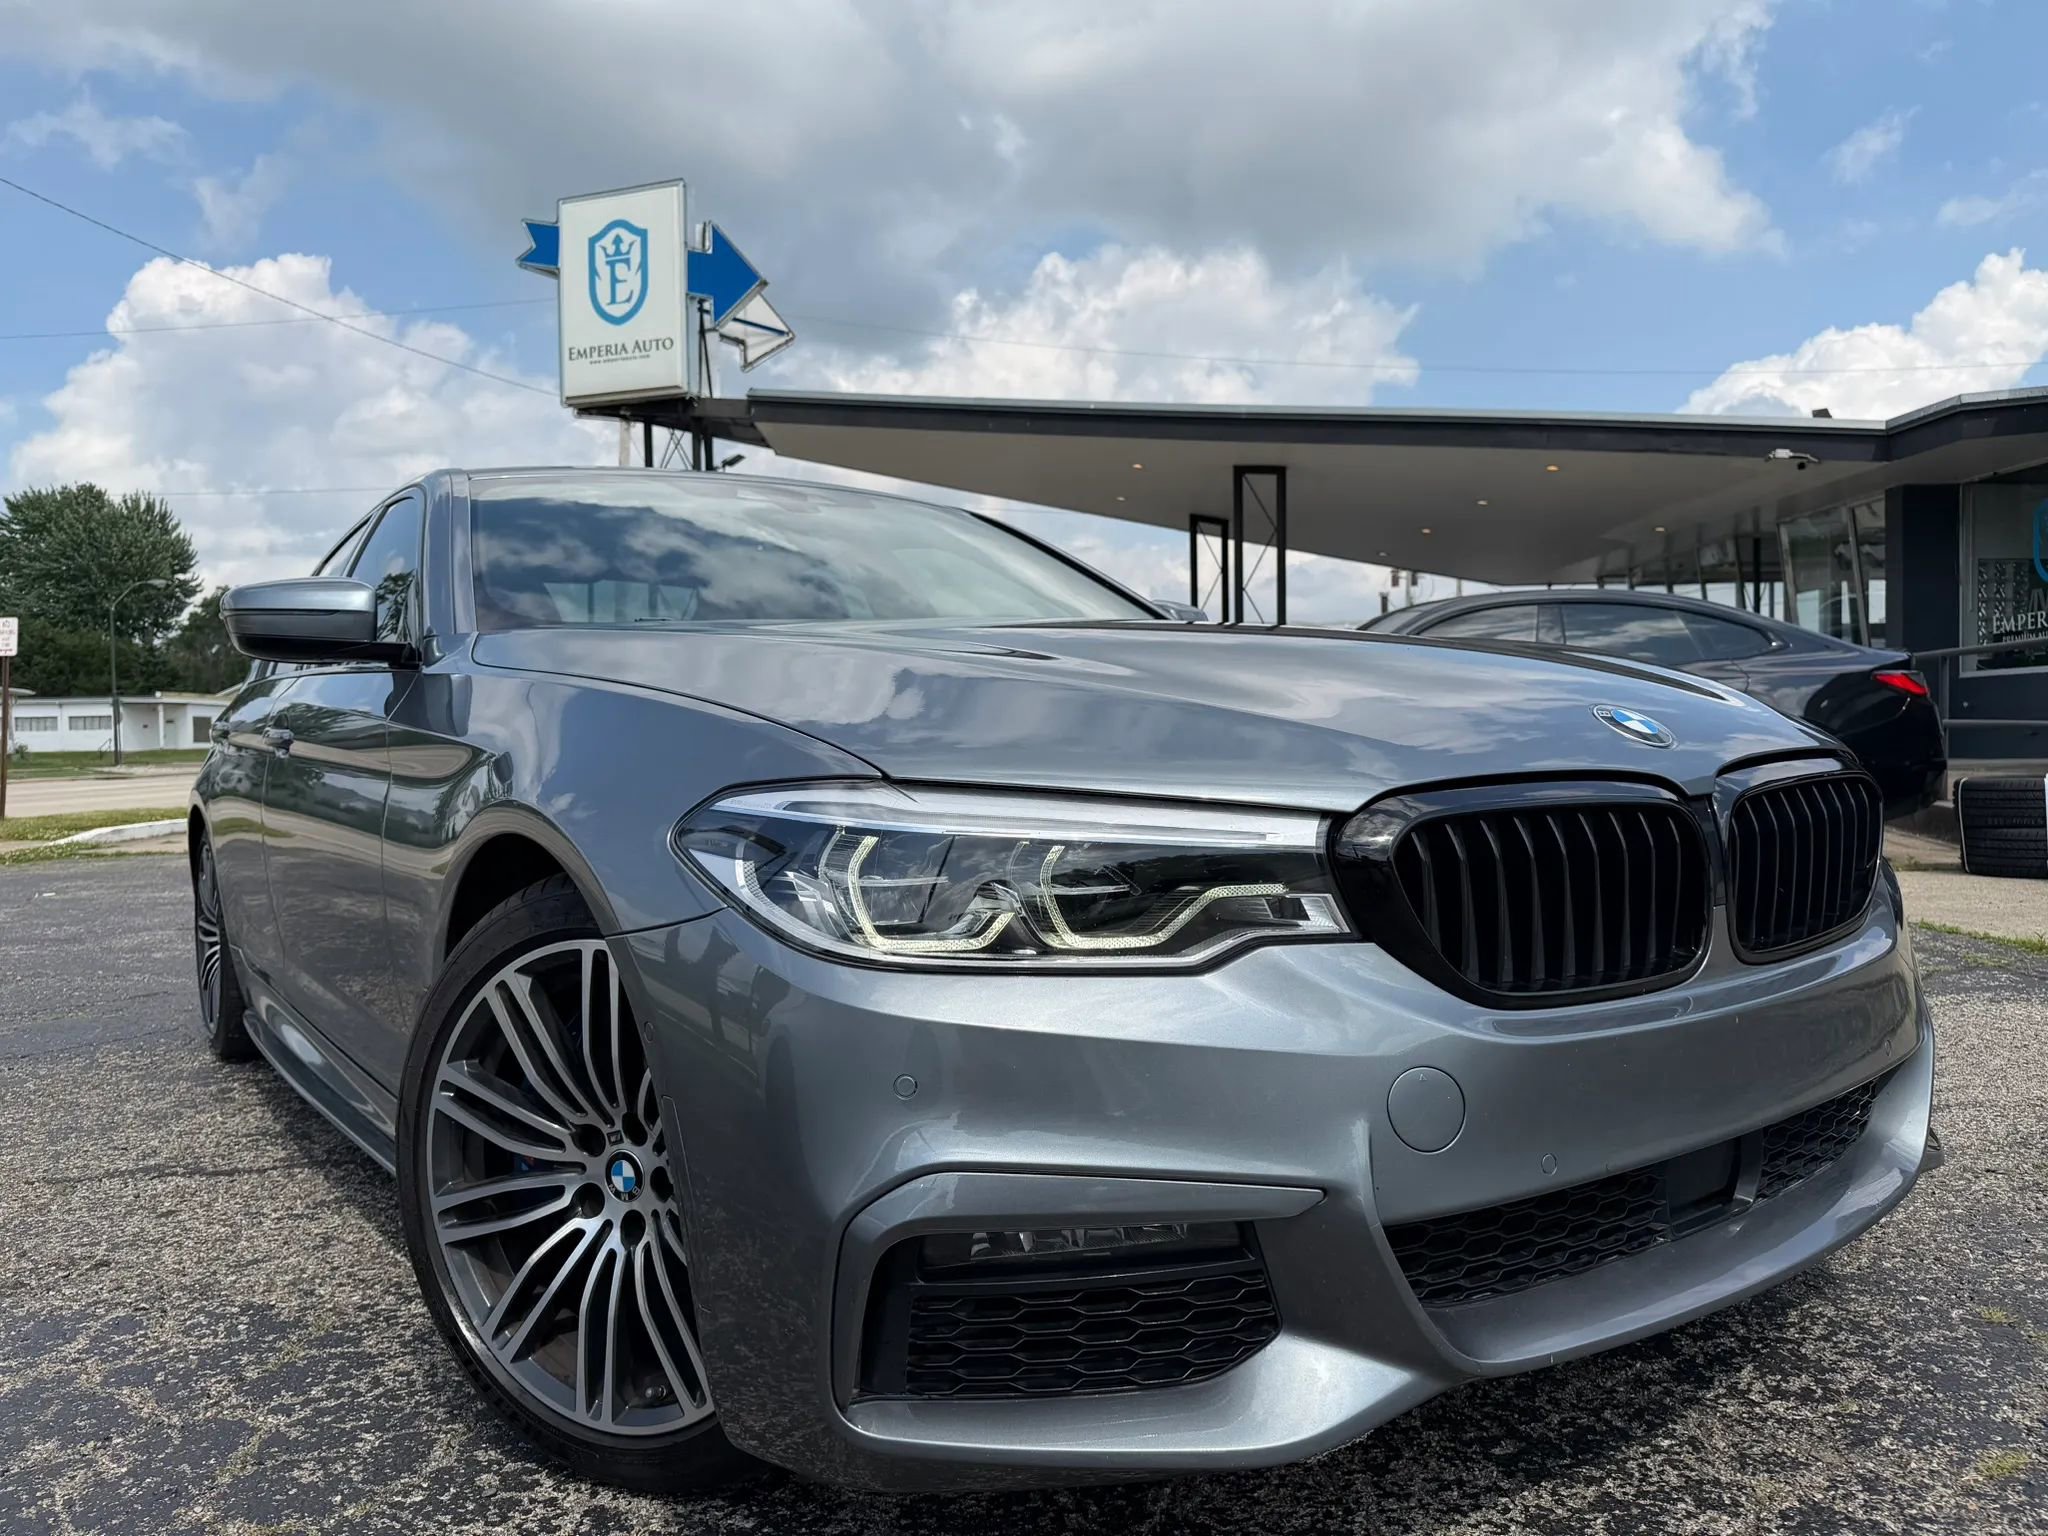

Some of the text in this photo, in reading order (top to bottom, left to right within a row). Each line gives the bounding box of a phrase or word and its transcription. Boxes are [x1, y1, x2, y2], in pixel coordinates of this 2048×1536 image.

[605, 256, 634, 306] E
[568, 342, 629, 361] EMPERIA
[632, 337, 674, 354] AUTO
